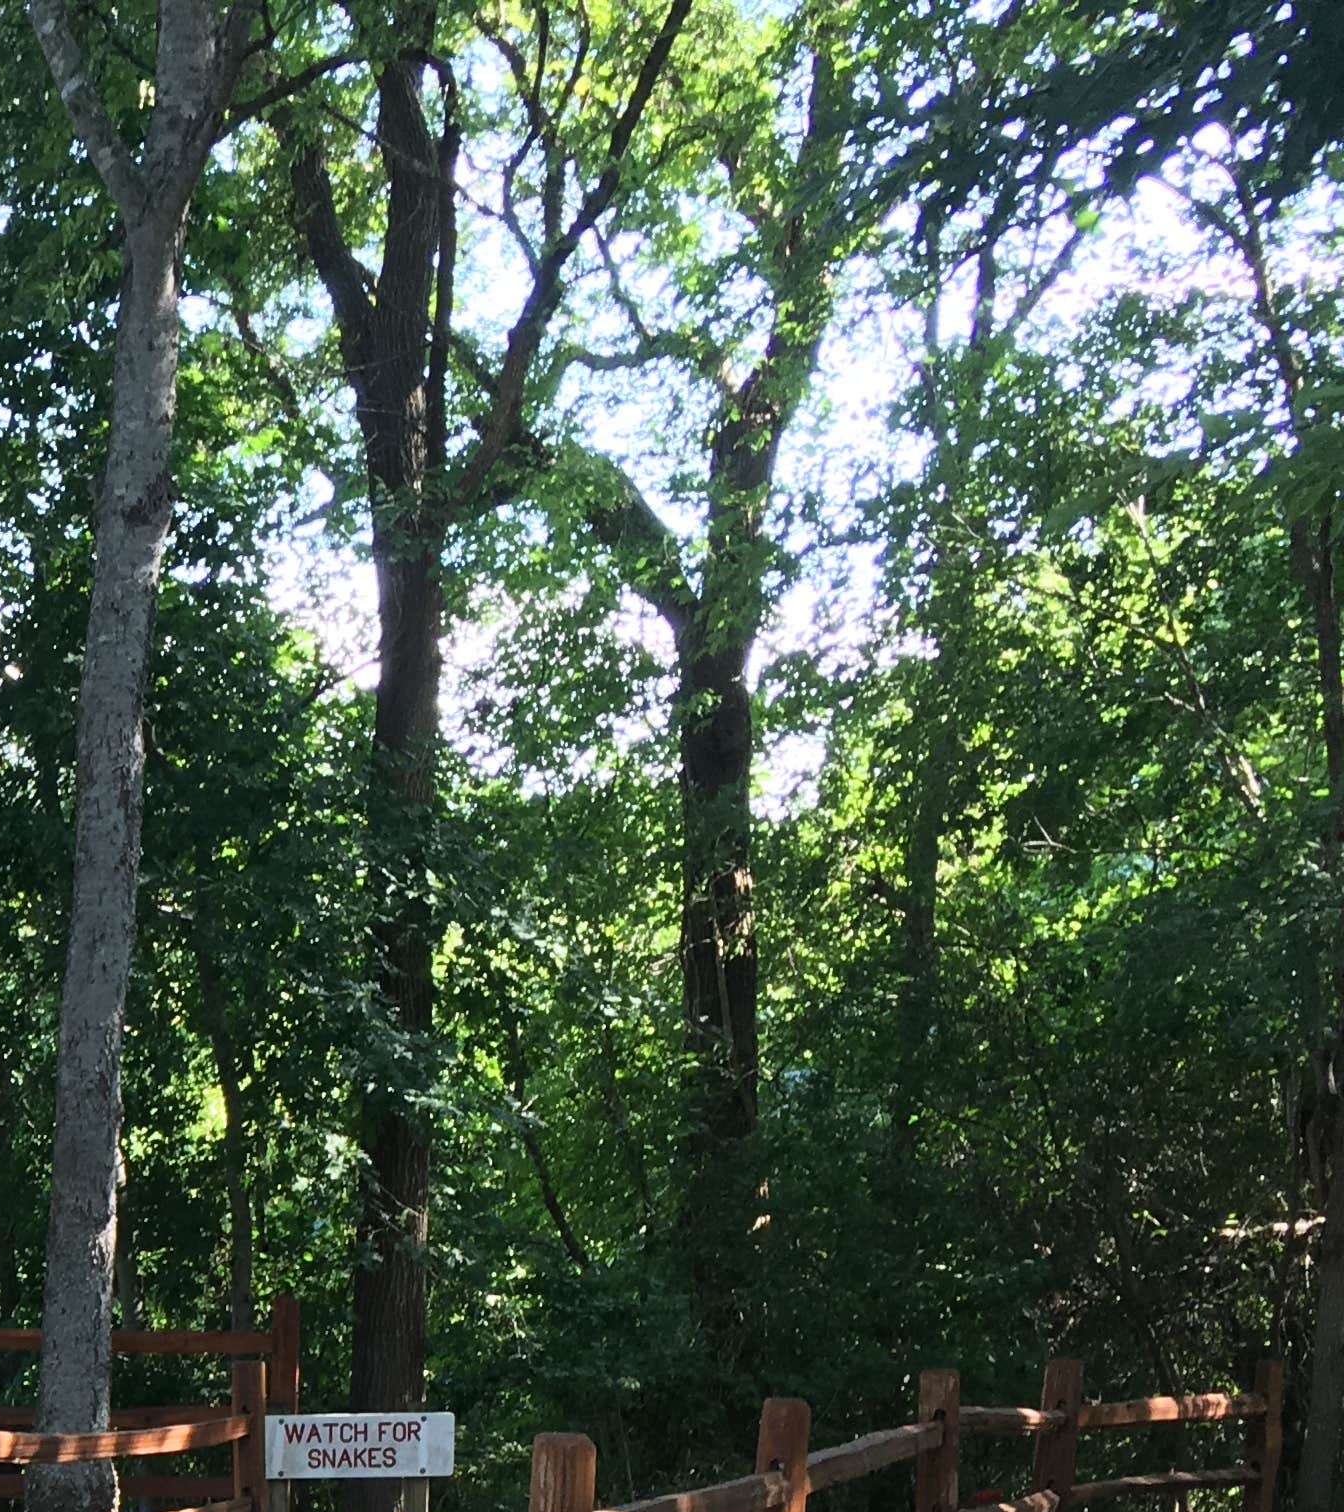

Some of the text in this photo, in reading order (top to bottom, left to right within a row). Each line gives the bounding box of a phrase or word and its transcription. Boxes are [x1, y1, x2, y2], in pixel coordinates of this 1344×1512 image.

[284, 1421, 421, 1443] WATCH FOR
[307, 1447, 397, 1469] SNAKES
